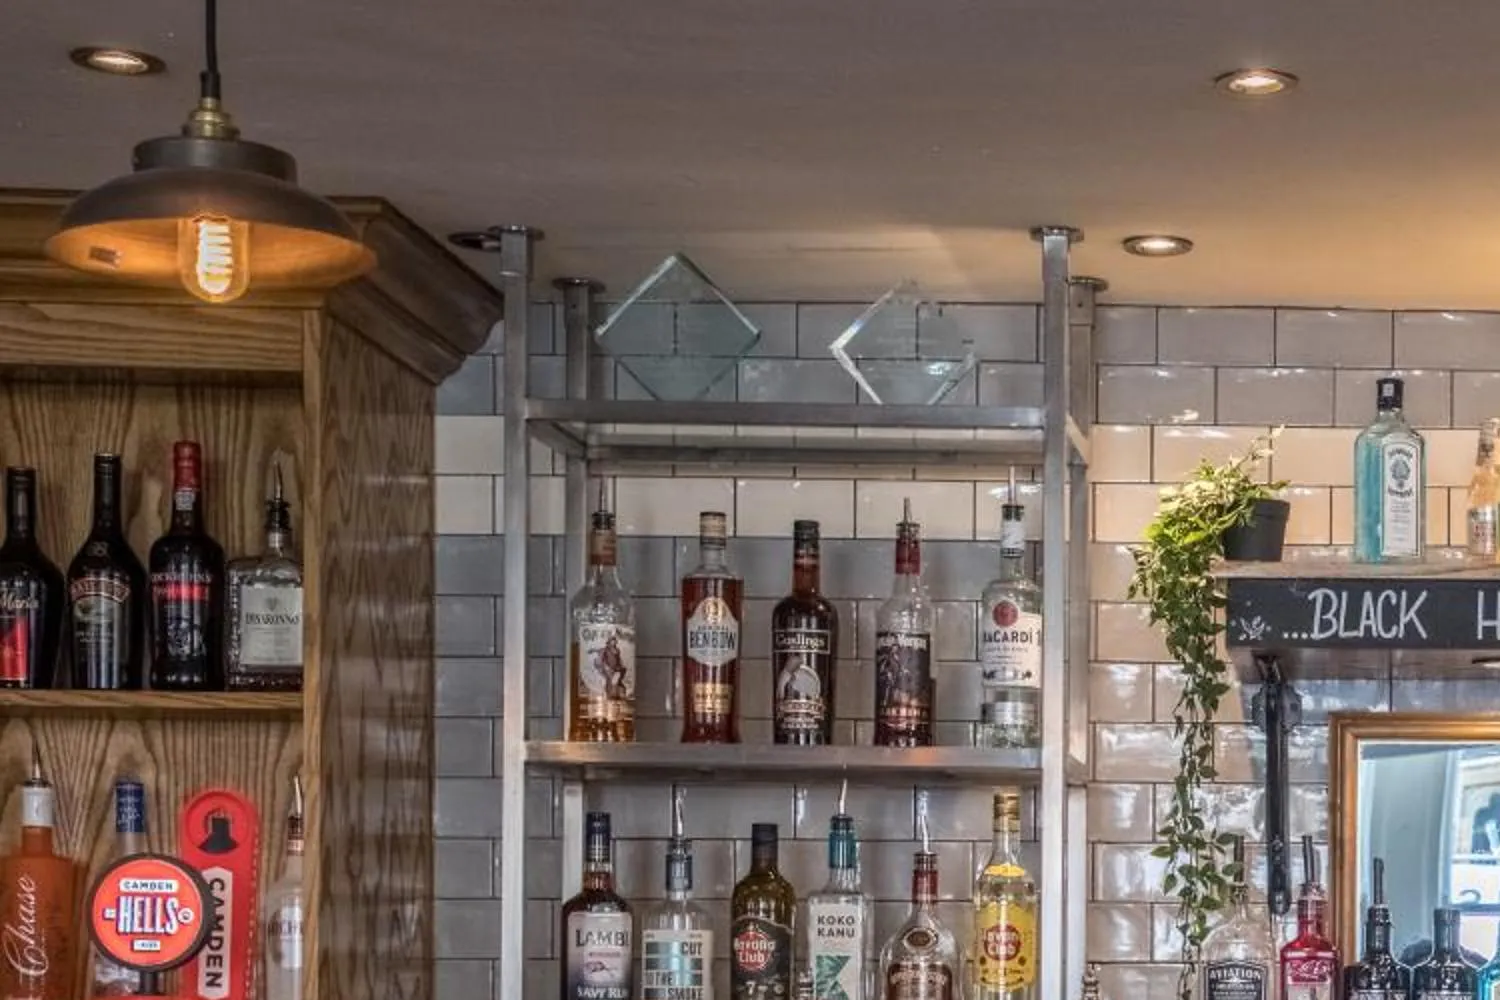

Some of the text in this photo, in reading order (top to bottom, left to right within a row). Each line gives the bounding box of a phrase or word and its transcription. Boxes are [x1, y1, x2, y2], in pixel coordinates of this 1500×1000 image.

[123, 880, 174, 891] CAMDEN
[117, 896, 179, 934] HELLS
[817, 915, 856, 925] KOKO
[817, 928, 856, 938] KANU
[1208, 967, 1263, 979] AVIATION
